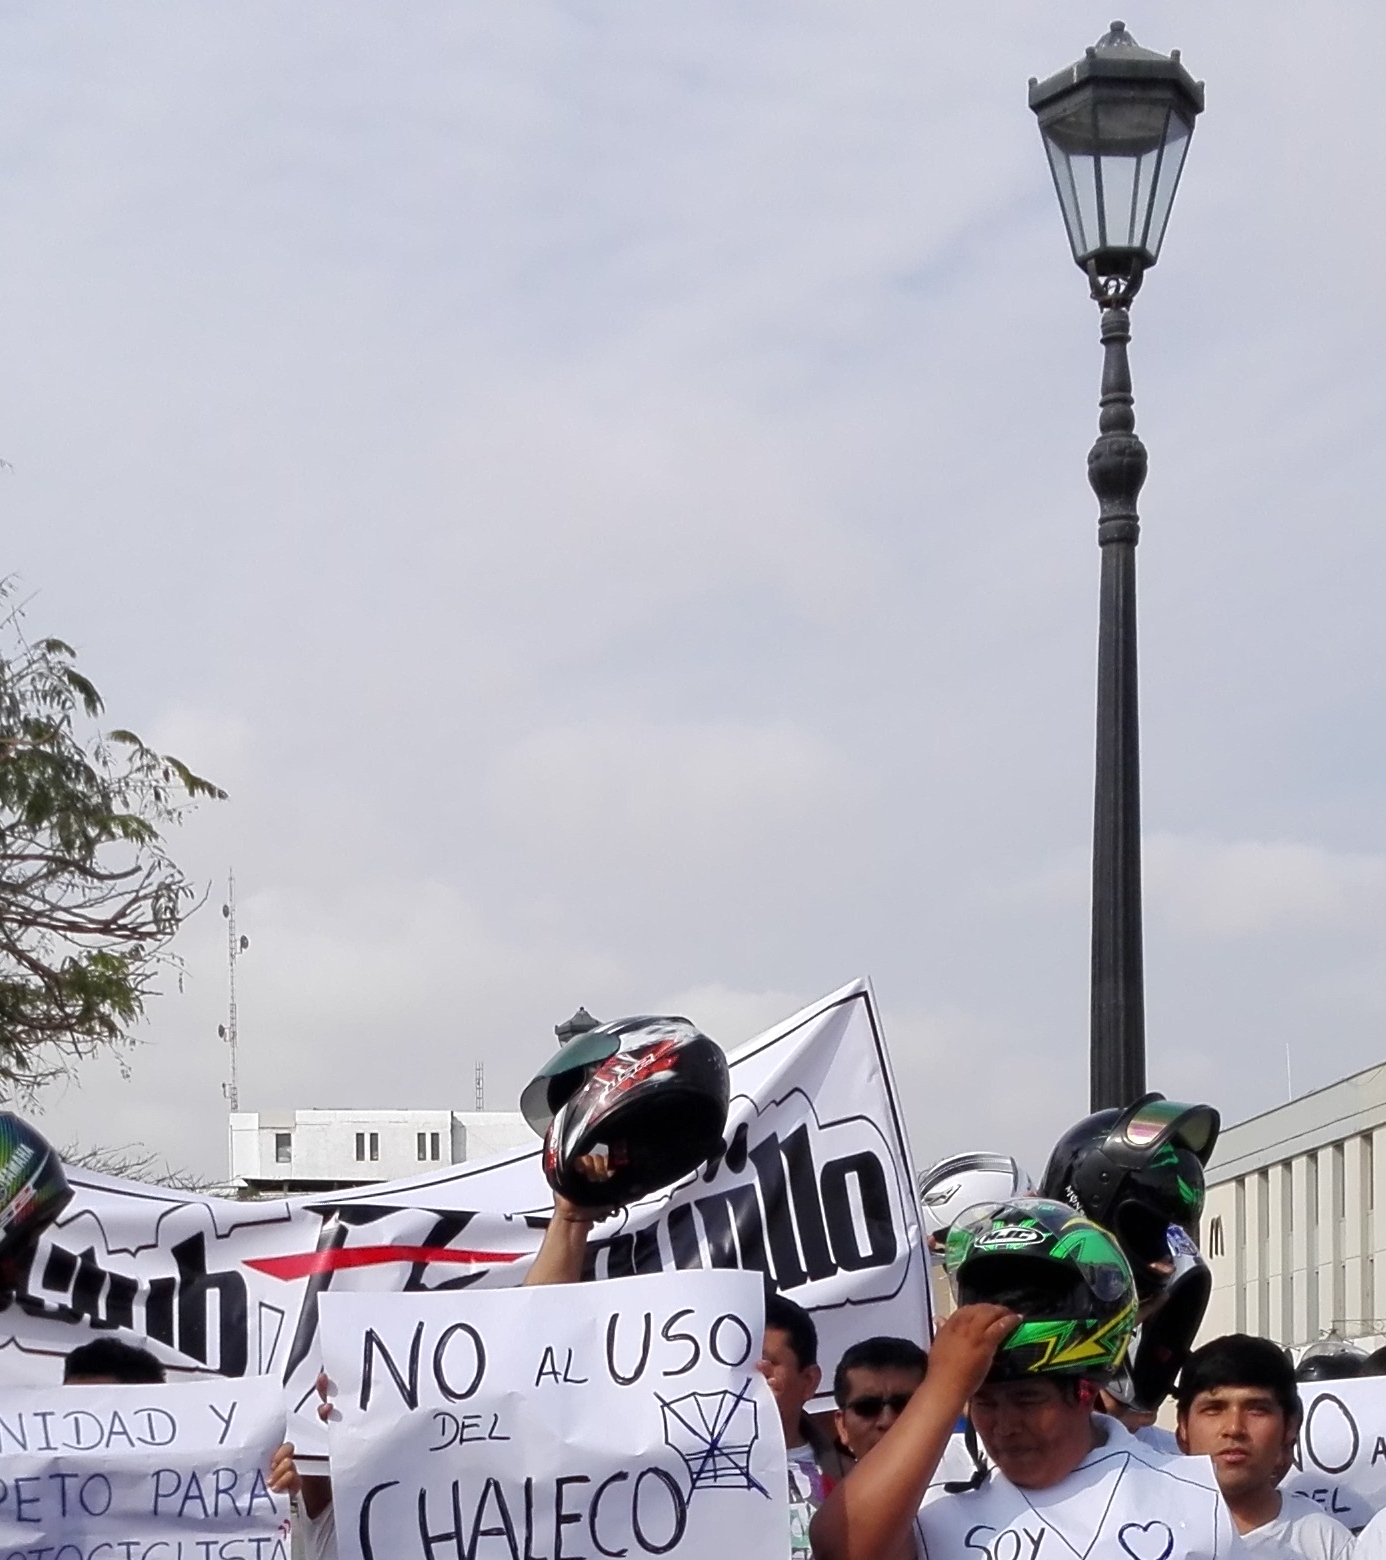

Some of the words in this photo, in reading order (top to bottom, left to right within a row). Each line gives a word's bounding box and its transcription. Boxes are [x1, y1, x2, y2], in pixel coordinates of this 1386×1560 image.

[359, 1320, 487, 1411] NO
[534, 1346, 589, 1388] AL
[605, 1308, 752, 1386] USO
[209, 1401, 237, 1444] Y
[428, 1412, 511, 1451] DEL
[150, 1468, 278, 1518] PARA
